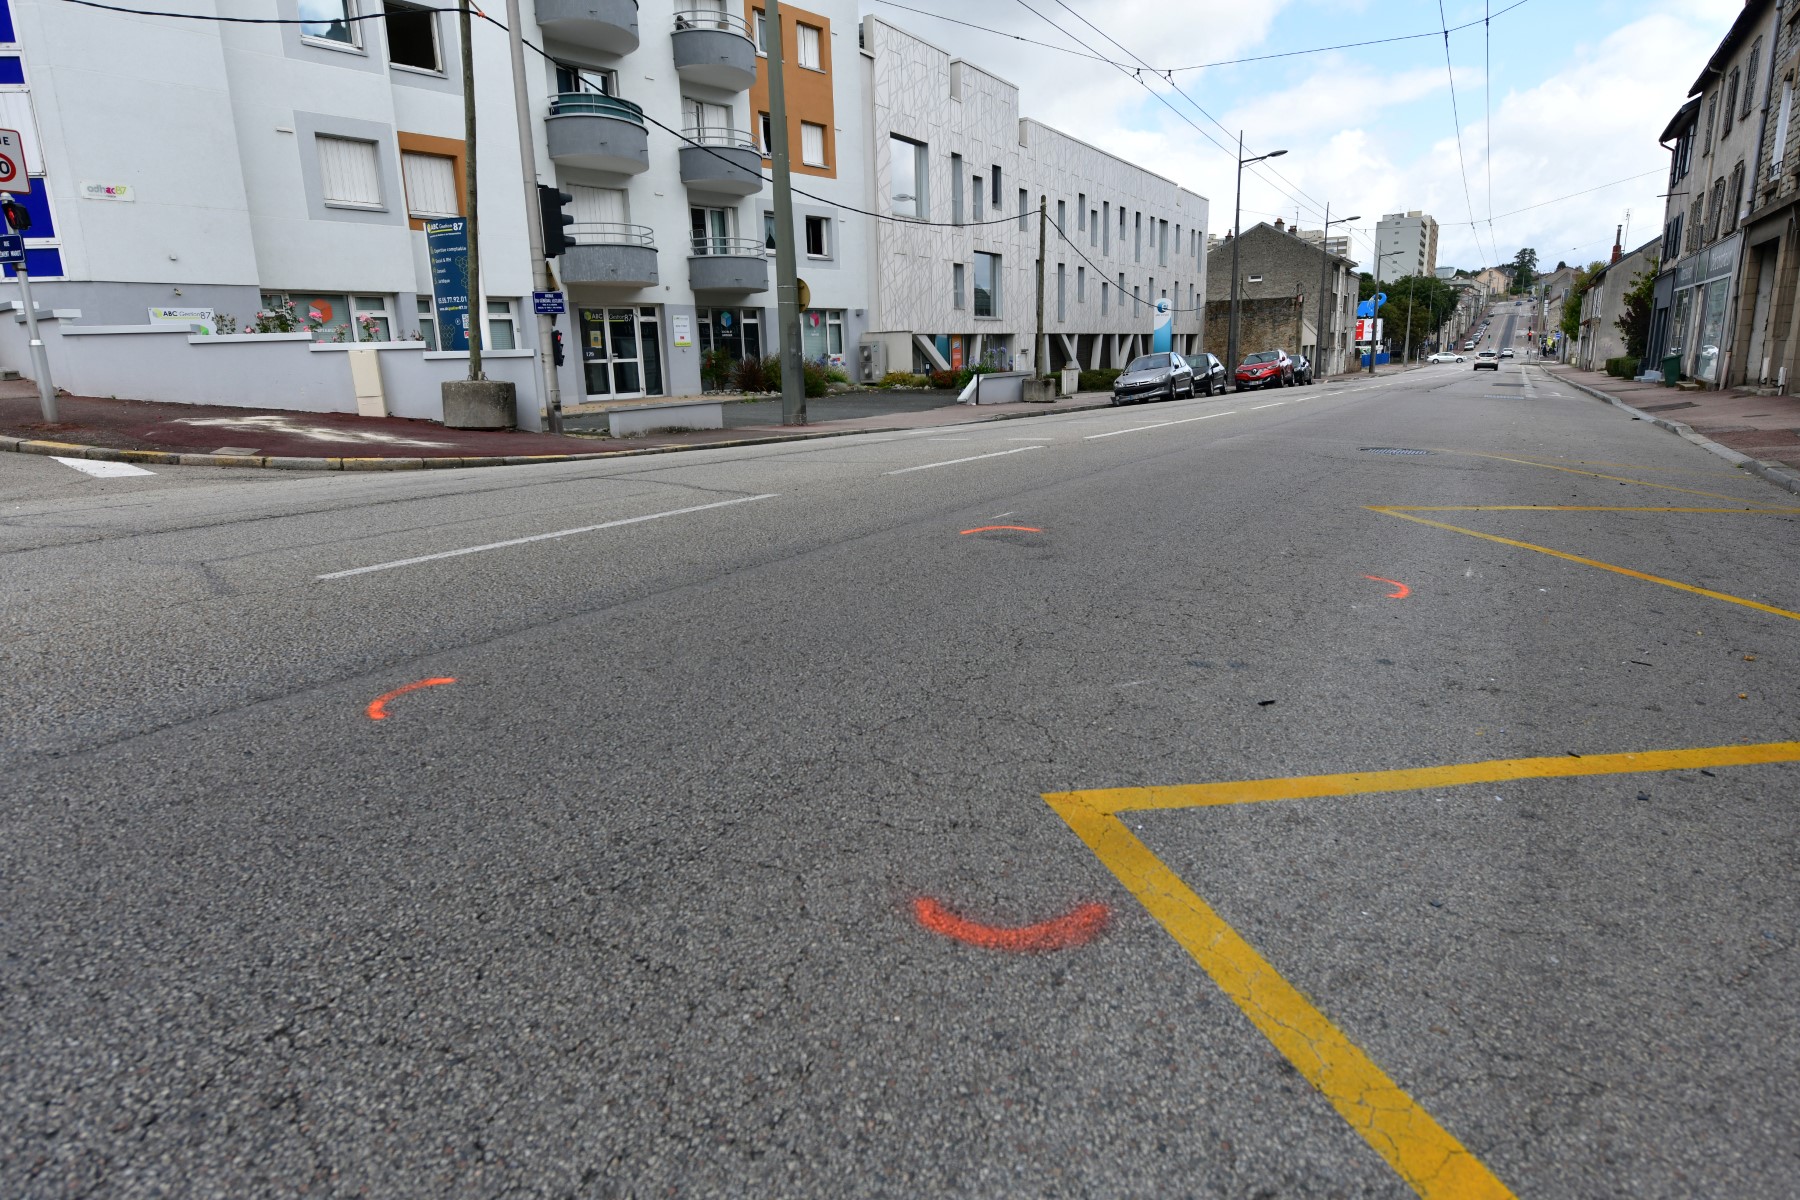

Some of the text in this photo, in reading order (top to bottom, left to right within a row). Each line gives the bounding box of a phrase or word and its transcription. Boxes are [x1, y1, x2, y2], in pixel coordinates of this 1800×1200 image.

[87, 185, 126, 195] odhac87
[453, 222, 463, 231] 87
[200, 312, 212, 320] 87
[624, 314, 633, 323] 87
